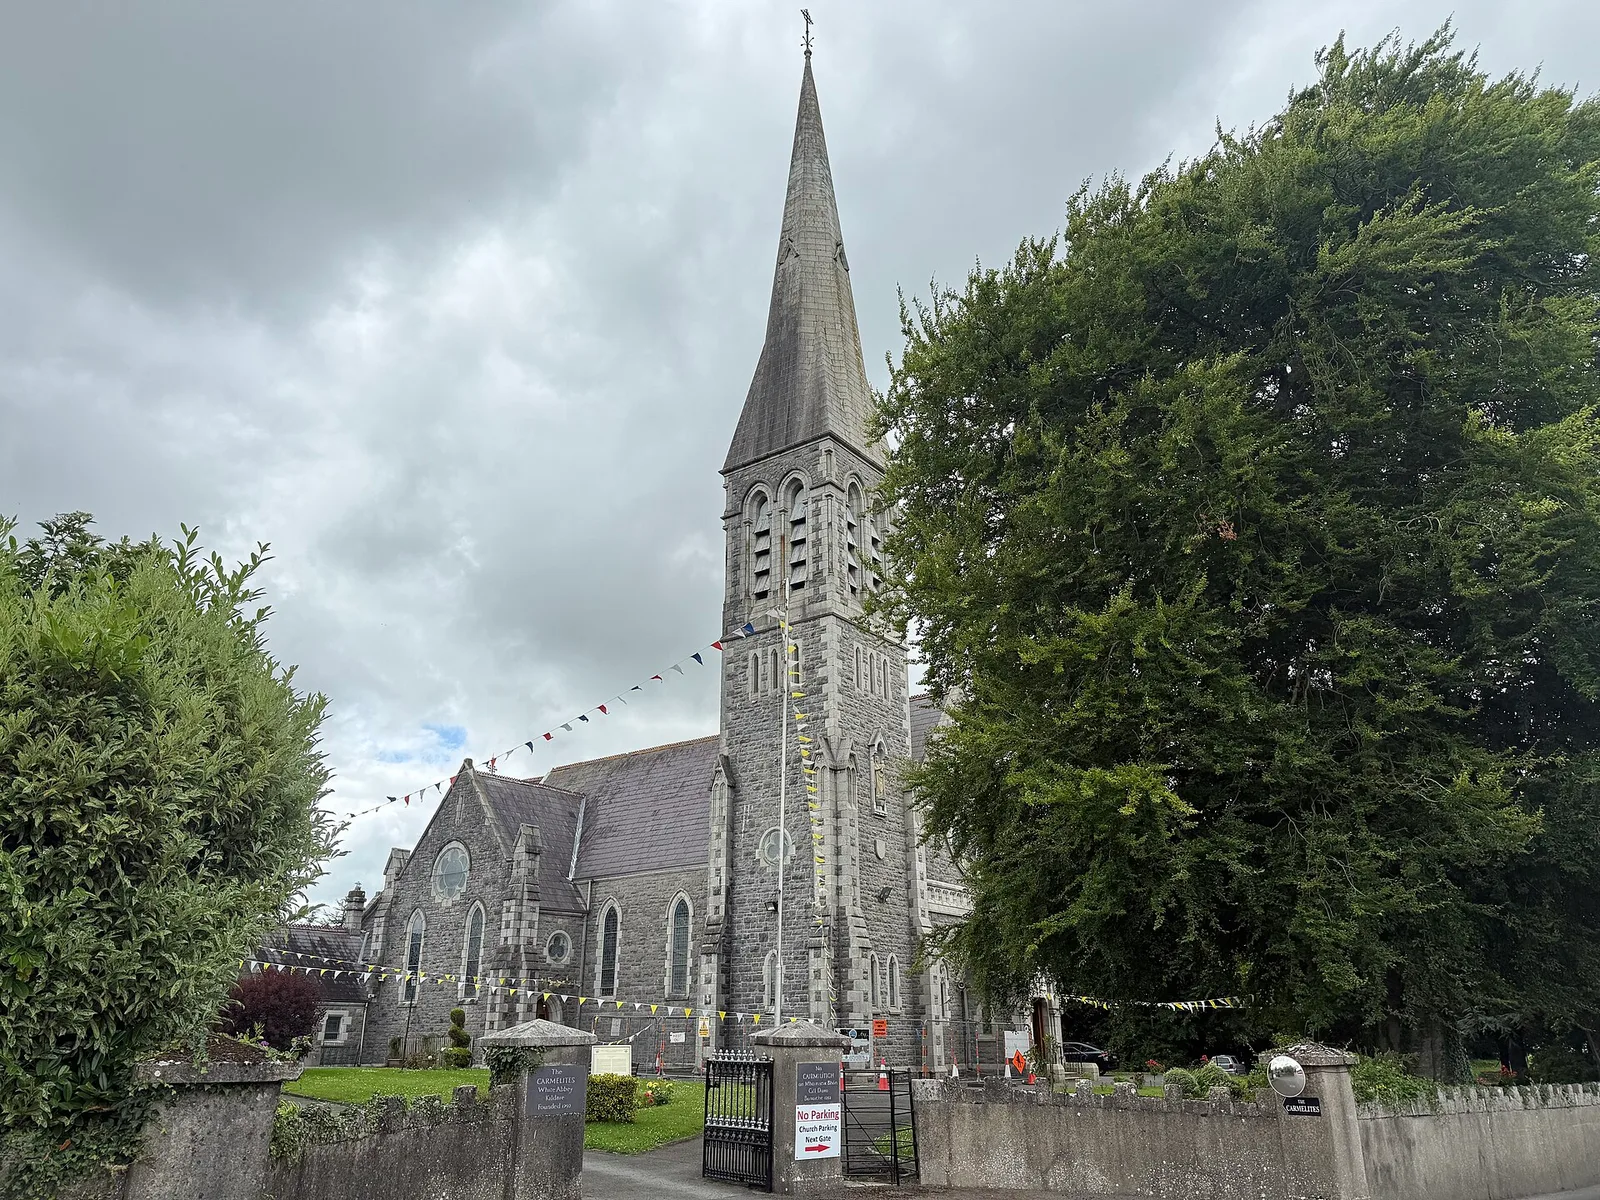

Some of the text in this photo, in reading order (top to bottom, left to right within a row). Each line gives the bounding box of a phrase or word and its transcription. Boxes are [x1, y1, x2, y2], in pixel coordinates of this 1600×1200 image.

[536, 1076, 576, 1085] CARMELITES
[556, 1086, 574, 1095] Abbey
[1285, 1104, 1320, 1113] CARMELITES
[797, 1109, 840, 1121] No Parking
[799, 1124, 838, 1133] Church Parking
